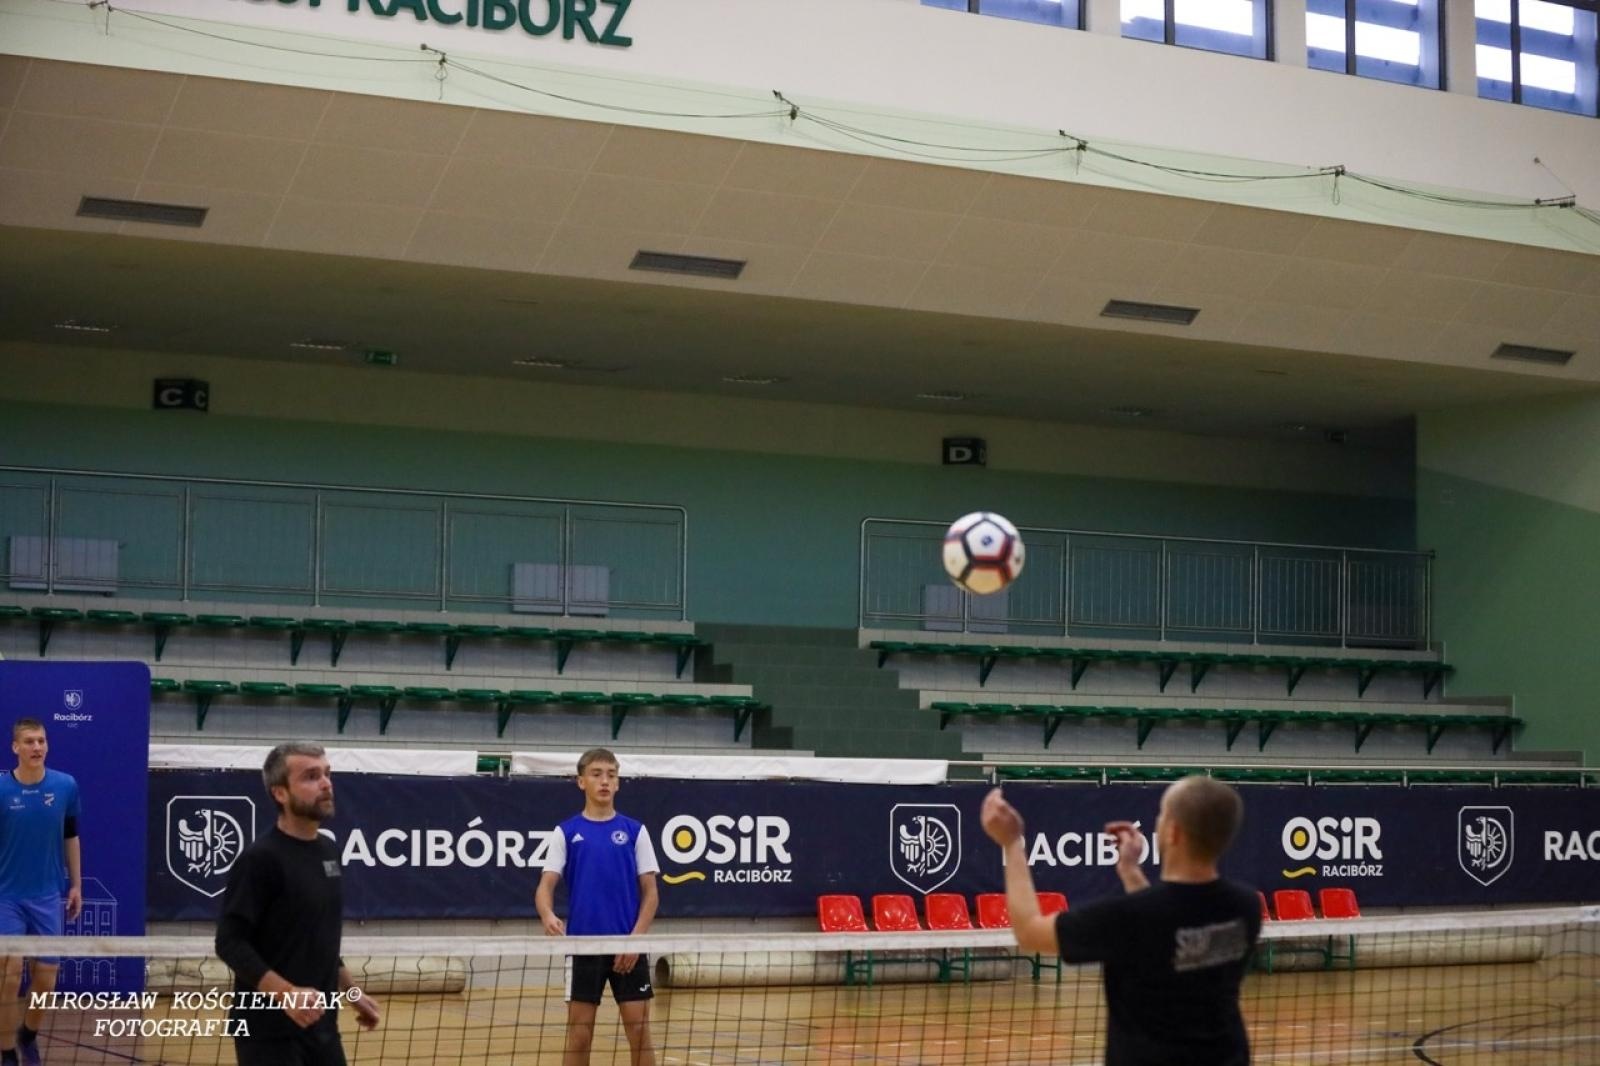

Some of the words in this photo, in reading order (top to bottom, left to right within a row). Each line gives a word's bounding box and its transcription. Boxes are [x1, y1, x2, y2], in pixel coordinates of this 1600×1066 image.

[161, 388, 183, 406] C
[949, 446, 972, 462] D
[317, 816, 553, 867] ACIBÓRZ
[661, 814, 793, 864] OSiR
[1002, 820, 1161, 867] ACIB
[1281, 816, 1383, 861] OSiR
[1544, 830, 1600, 861] RAC
[713, 866, 793, 883] RACIBÓRZ
[1322, 861, 1384, 877] RACIBÓRZ
